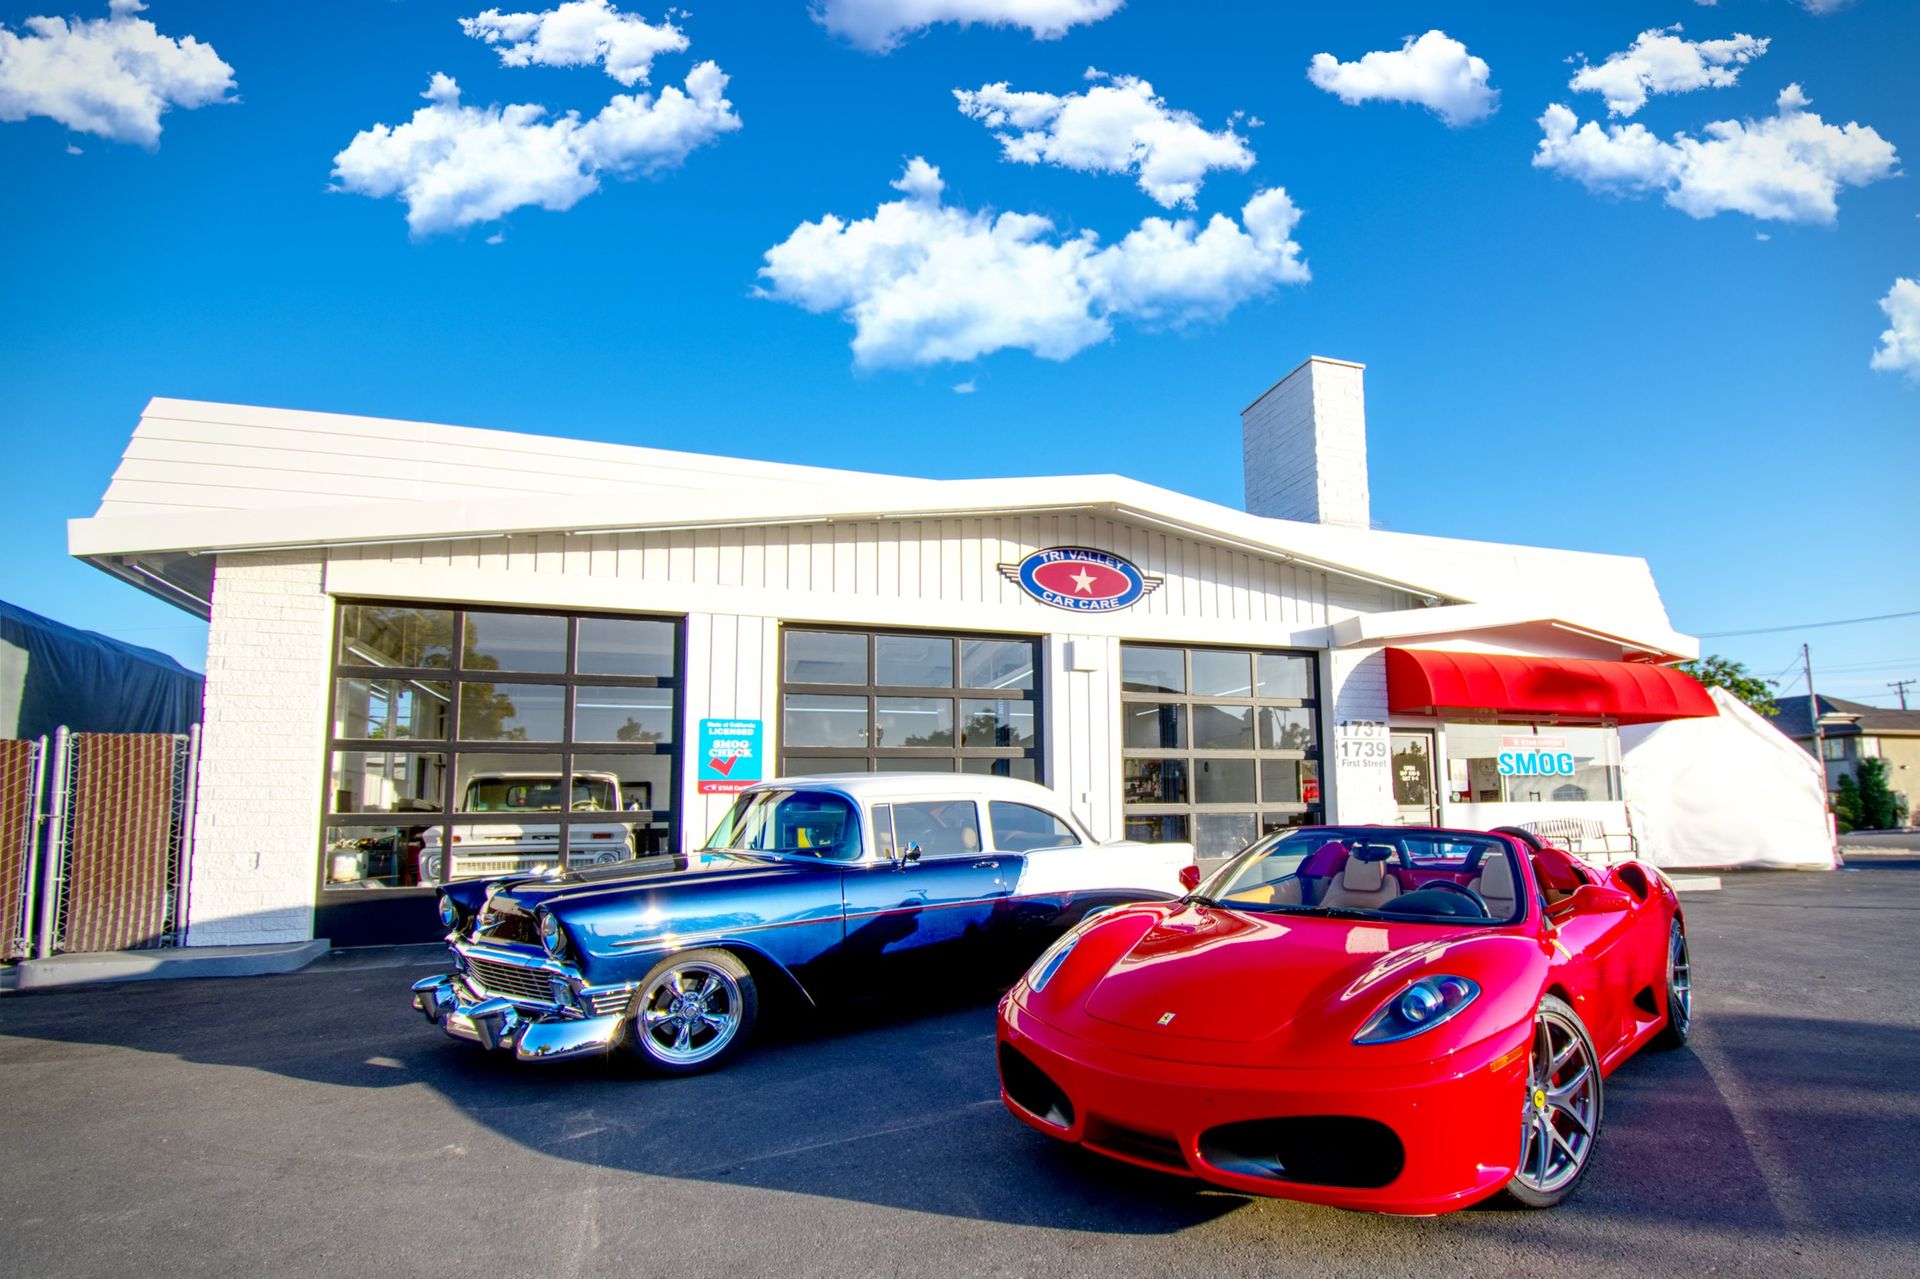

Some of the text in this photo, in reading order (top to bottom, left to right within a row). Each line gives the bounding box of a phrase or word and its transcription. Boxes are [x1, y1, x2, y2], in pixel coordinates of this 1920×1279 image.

[1040, 550, 1124, 570] TRI VALLEY
[1042, 591, 1120, 610] CAR CARE
[708, 728, 754, 736] LICENSED
[1340, 720, 1385, 737] 1737
[713, 739, 749, 749] SMOG
[1340, 741, 1387, 757] 1739
[708, 748, 753, 758] CHECK
[1341, 759, 1387, 767] First Street
[1498, 752, 1574, 775] SMOG
